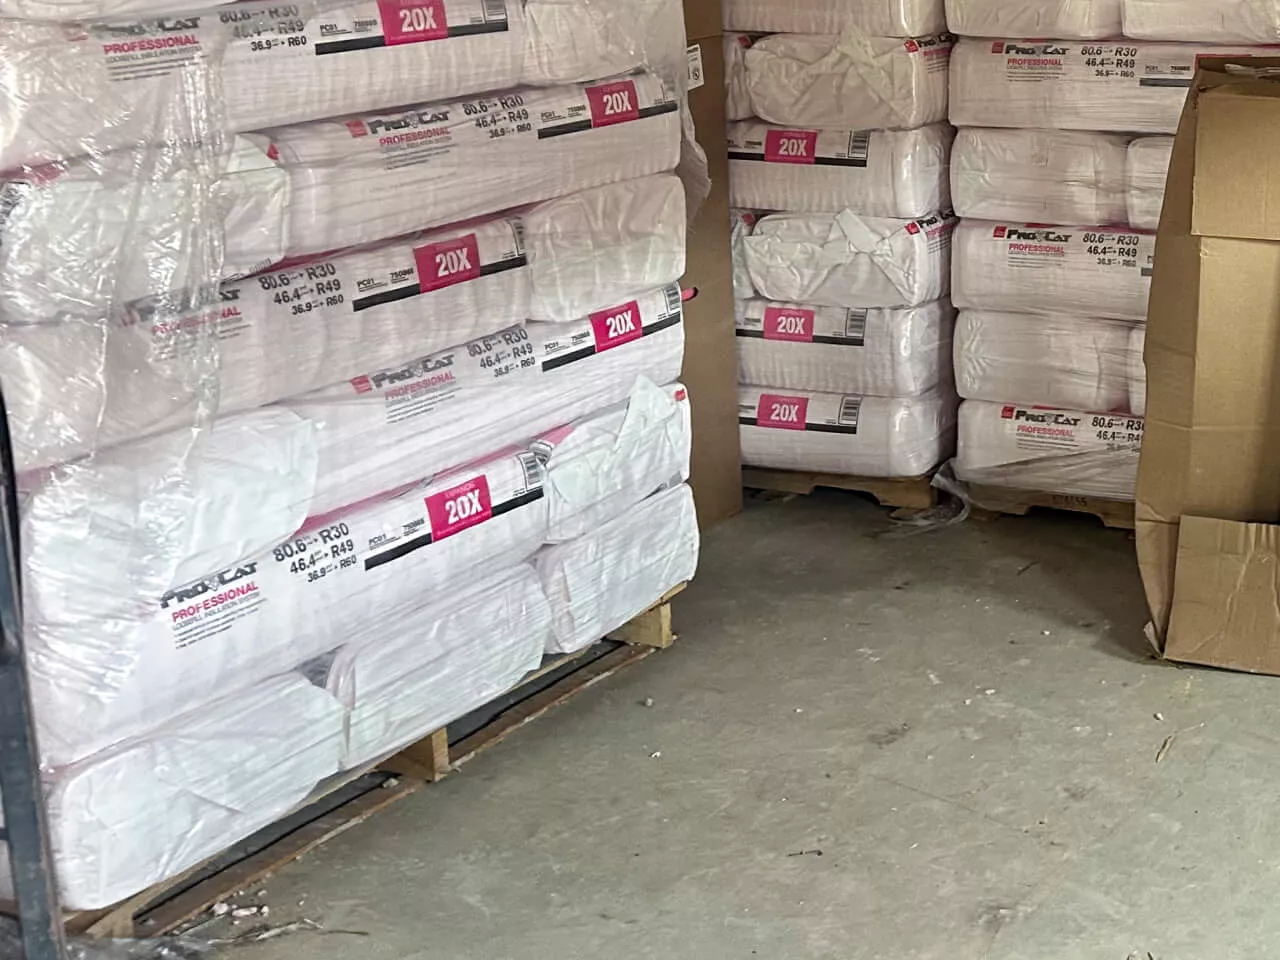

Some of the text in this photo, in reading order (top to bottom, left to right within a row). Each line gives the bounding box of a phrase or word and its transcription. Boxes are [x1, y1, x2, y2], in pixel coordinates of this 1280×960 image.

[400, 7, 437, 32] 20X
[103, 35, 199, 54] PROFESSIONAL
[252, 36, 307, 51] 36.9 R60
[1081, 47, 1137, 56] 80.6 R30
[1085, 58, 1135, 68] 46.4 R49
[463, 96, 524, 115] 80.6 R30
[603, 91, 632, 115] 20X
[475, 110, 529, 128] 46.4 R49
[380, 126, 450, 146] PROFESSIONAL
[779, 138, 807, 156] 20X
[1009, 243, 1064, 253] PROFESSIONAL
[1083, 233, 1139, 245] 80.6 R30
[1087, 246, 1137, 257] 46.4 R49
[435, 248, 472, 277] 20X
[259, 263, 336, 290] 80.6 R30
[274, 280, 341, 304] 46.4 R49
[292, 295, 344, 315] 36.9 R60
[606, 311, 635, 338] 20X
[776, 316, 805, 334] 20X
[467, 329, 528, 356] 80.6 R30
[480, 344, 533, 368] 46.4 R49
[521, 357, 535, 368] R60
[384, 371, 454, 400] PROFESSIONAL
[771, 404, 799, 422] 20X
[1092, 417, 1114, 428] 80.6
[1017, 425, 1074, 436] PROFESSIONAL
[1097, 431, 1143, 442] 46.4 R4
[445, 489, 483, 524] 20X
[273, 522, 349, 562] 80.6 R30
[290, 540, 353, 574] 46.4 R49
[308, 555, 357, 583] 36.9 R60
[172, 581, 258, 622] PROFESSIONAL
